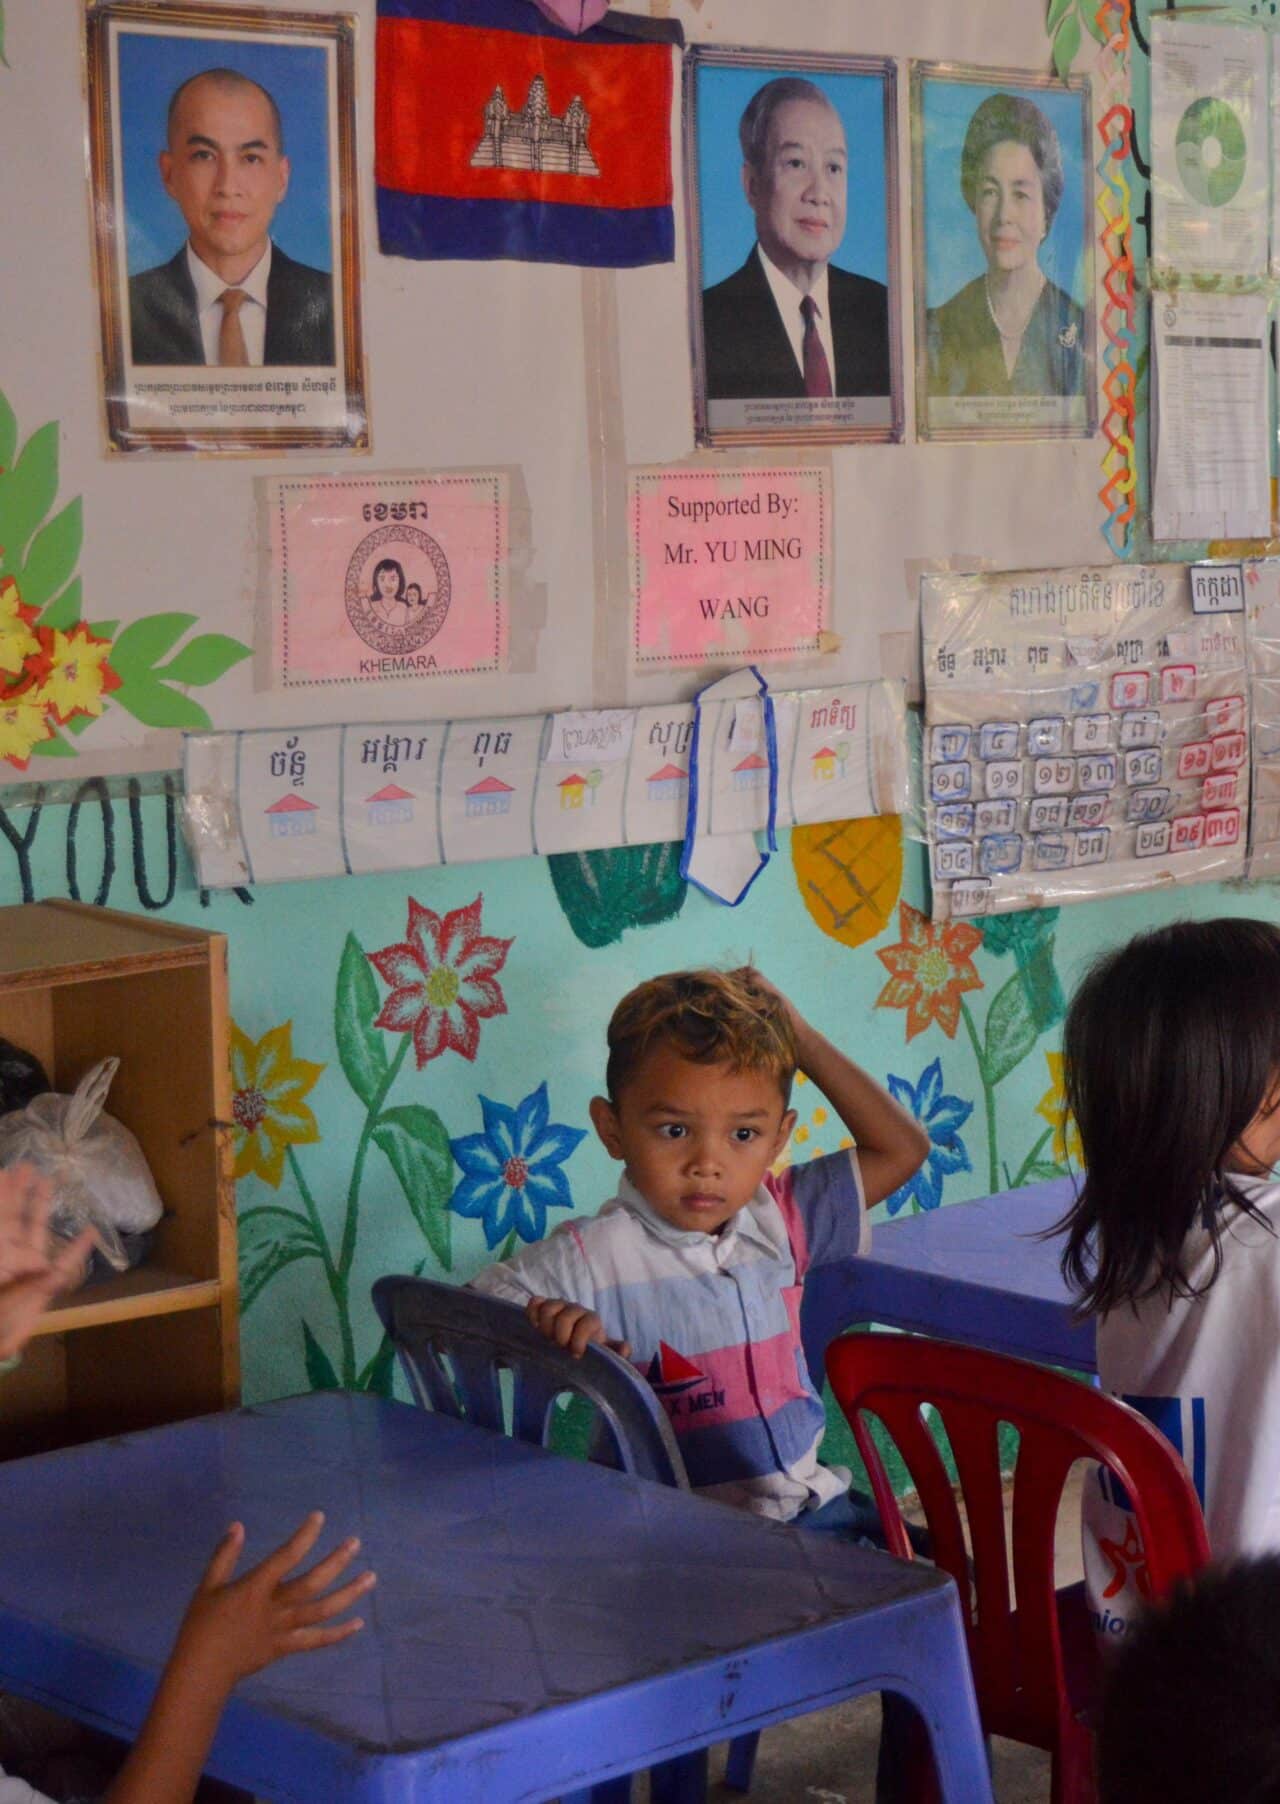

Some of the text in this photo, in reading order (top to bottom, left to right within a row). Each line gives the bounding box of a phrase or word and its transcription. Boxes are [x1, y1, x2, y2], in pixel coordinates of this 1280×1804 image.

[668, 492, 798, 523] Supported By:
[664, 538, 803, 564] Mr. YU MING
[699, 596, 769, 620] WANG
[359, 655, 437, 674] KHEMARA
[361, 734, 427, 773] អង្គារ
[473, 733, 513, 768] ពុធ
[0, 775, 254, 910] YOU
[688, 1387, 726, 1413] MEN
